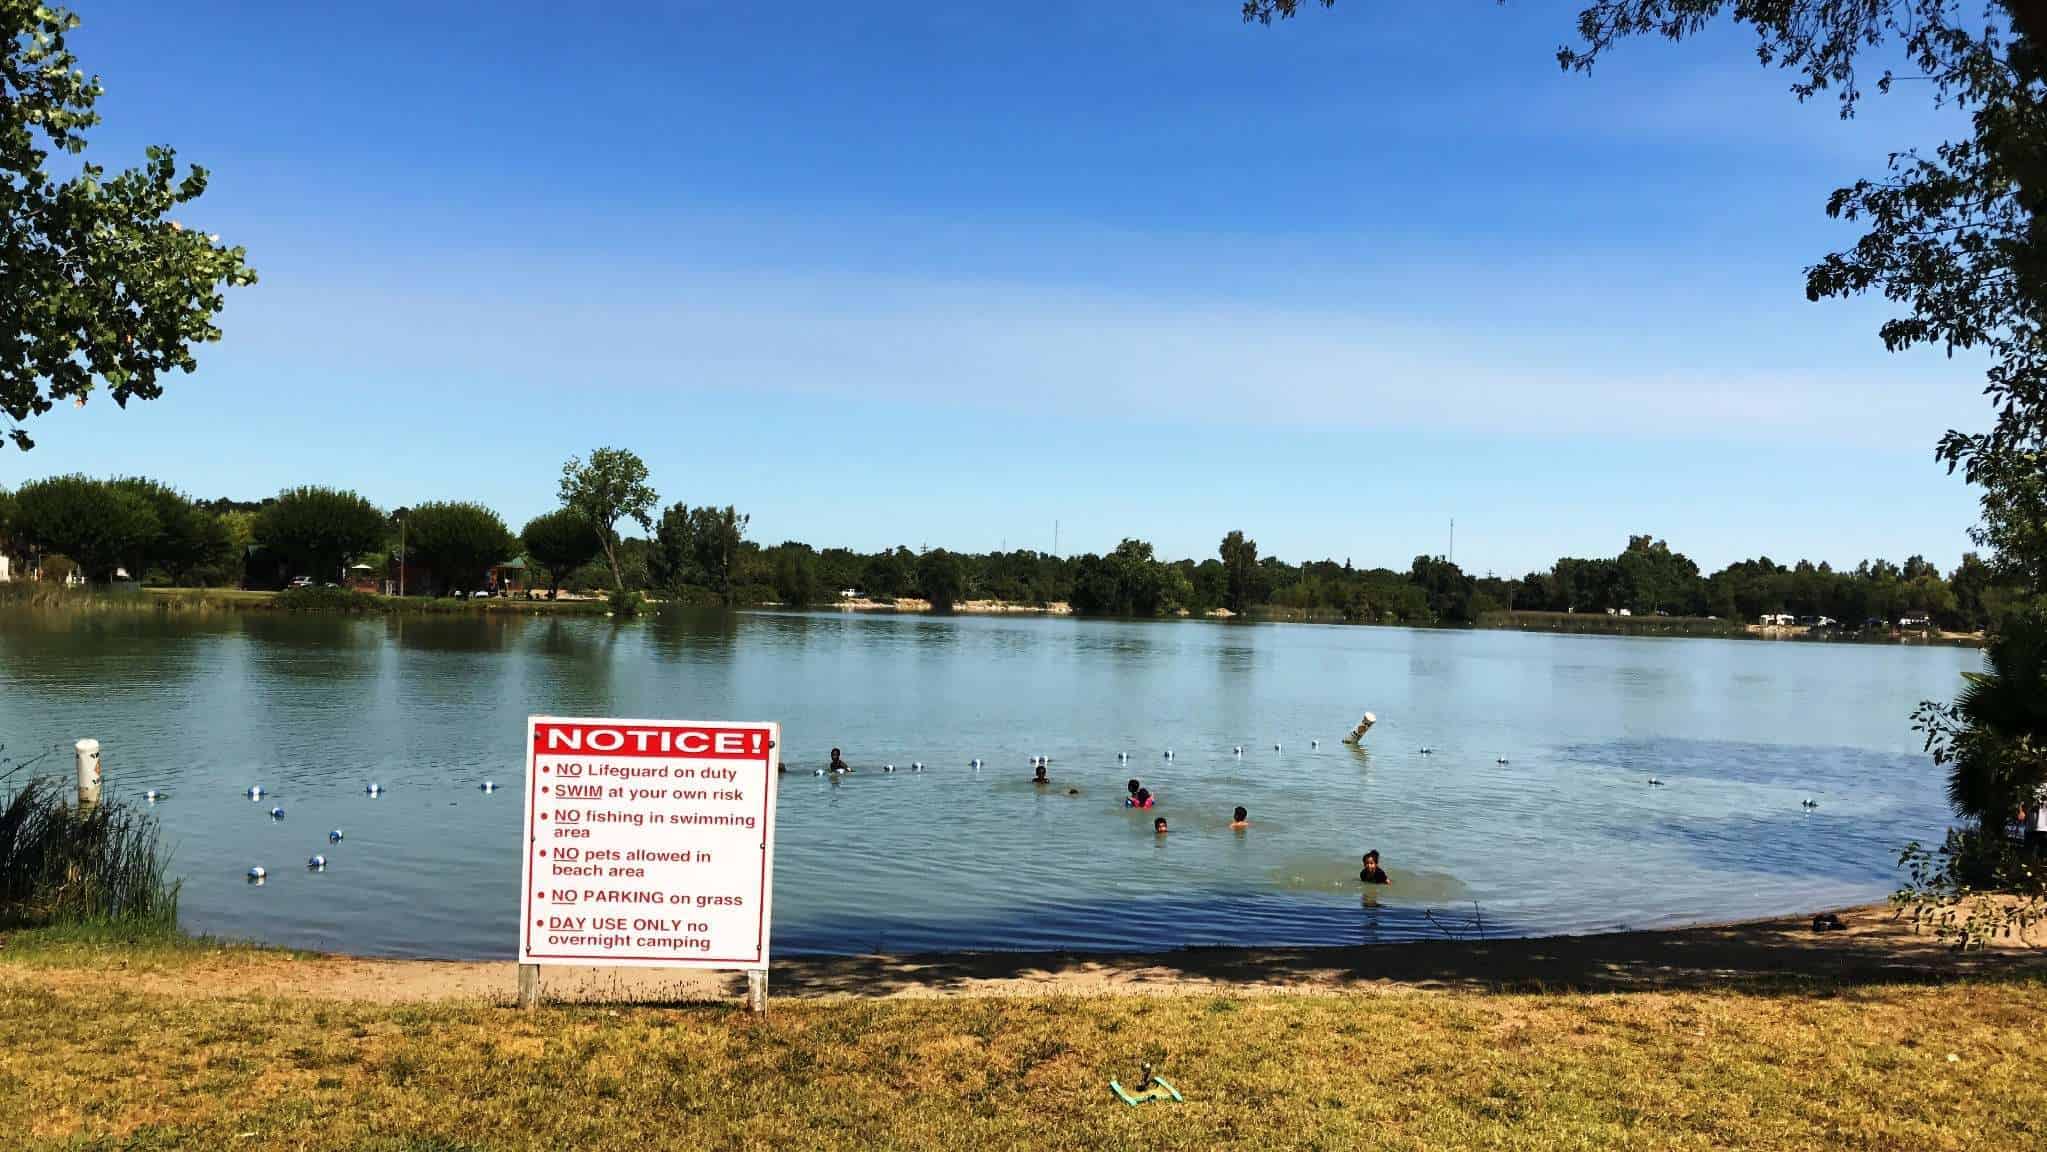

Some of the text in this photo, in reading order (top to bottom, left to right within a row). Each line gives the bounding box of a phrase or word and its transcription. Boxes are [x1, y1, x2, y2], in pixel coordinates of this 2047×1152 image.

[548, 728, 762, 754] NOTICE!
[556, 764, 736, 782] NO Lifeguard on duty
[555, 785, 743, 802] SWIM at your own risk
[554, 810, 755, 828] NO fishing in swimming
[554, 828, 590, 838] area
[553, 848, 711, 864] NO pets allowed in
[552, 864, 645, 878] beach area
[552, 890, 743, 908] NO PARKING on grass
[550, 917, 708, 932] DAY USE ONLY no
[548, 934, 711, 950] overnight camping
